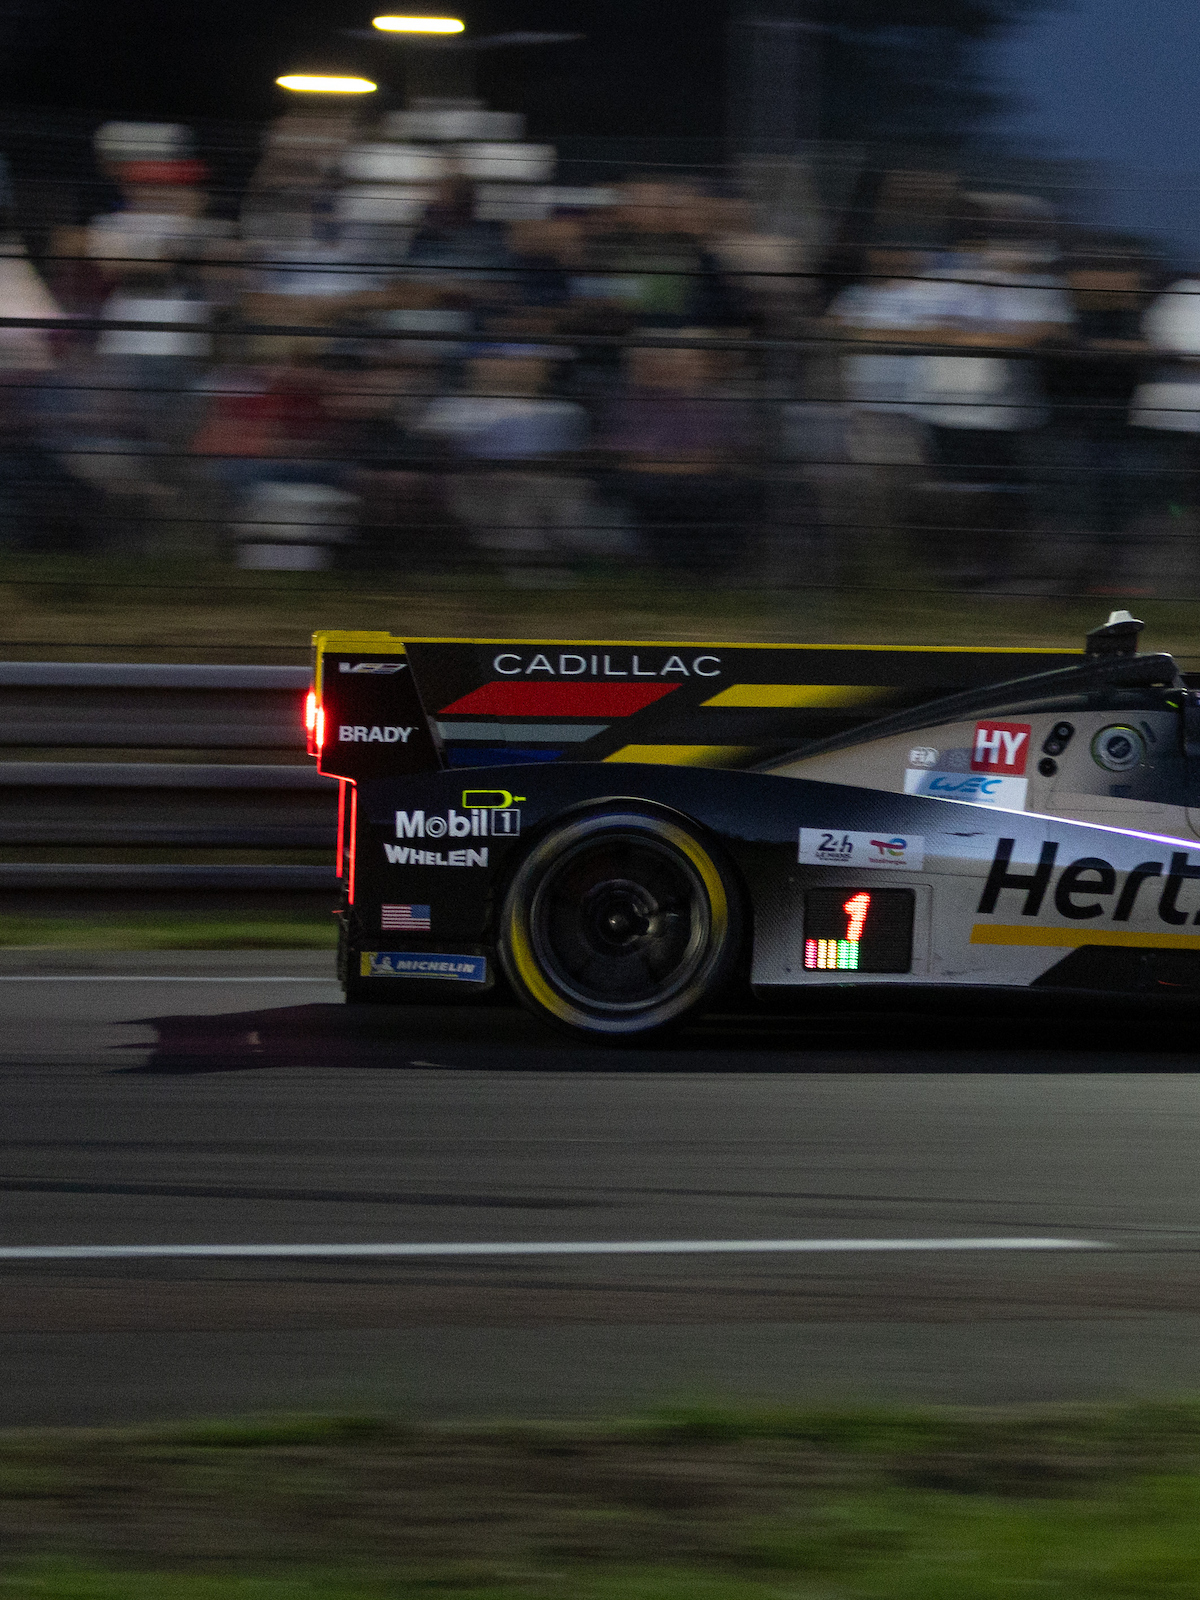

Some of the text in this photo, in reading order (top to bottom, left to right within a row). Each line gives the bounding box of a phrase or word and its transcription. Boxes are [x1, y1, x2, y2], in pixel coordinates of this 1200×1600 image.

[493, 653, 722, 677] CADILLAC
[338, 725, 413, 744] BRADY
[974, 728, 1028, 766] HY
[928, 776, 1003, 795] WEC
[395, 808, 488, 838] Mobil
[383, 842, 489, 868] WHELEN
[396, 959, 476, 974] MICHELIN
